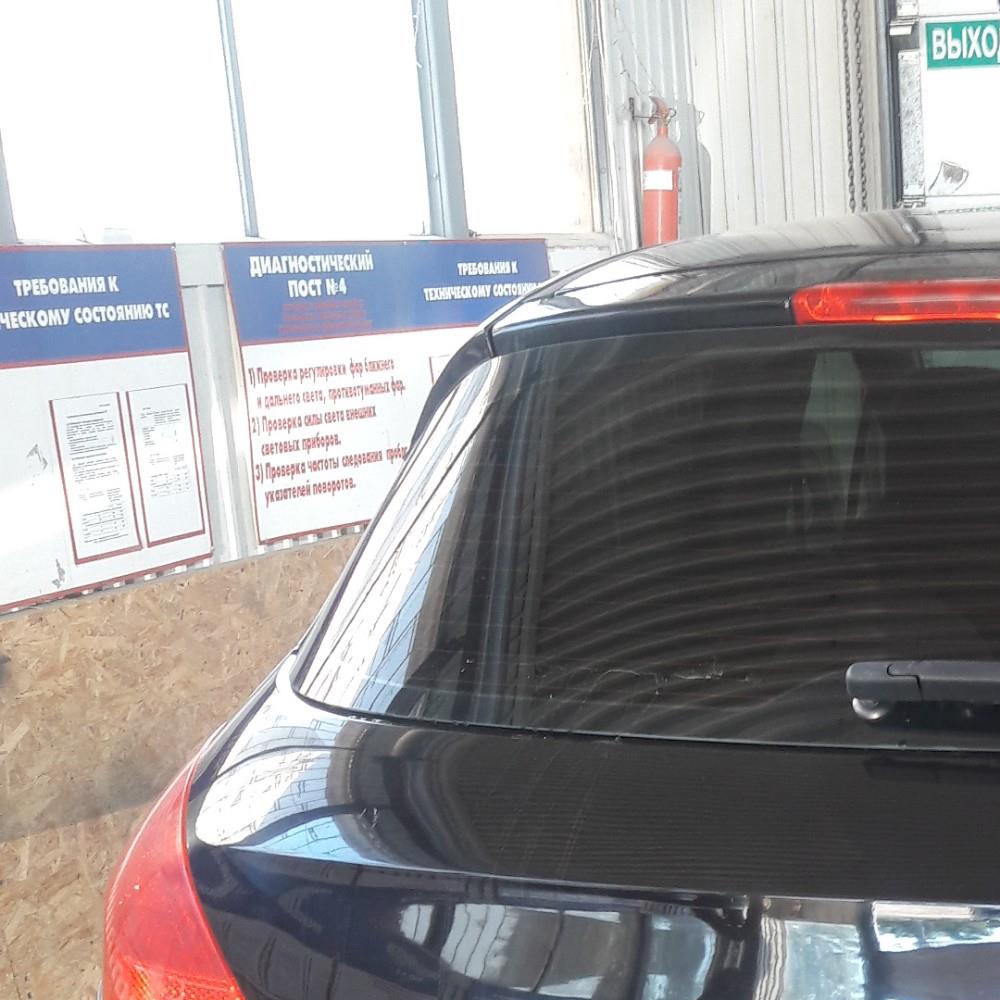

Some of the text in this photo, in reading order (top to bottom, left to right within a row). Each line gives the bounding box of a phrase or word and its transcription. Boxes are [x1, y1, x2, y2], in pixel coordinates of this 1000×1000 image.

[249, 249, 374, 277] ДИАГНОСТИЧЕСКИЙ
[457, 261, 518, 276] ТРЕБОВАНИЯ К
[13, 276, 119, 297] ТРЕБОВАНИЯ К
[288, 279, 322, 297] ПОСТ
[424, 284, 491, 301] ТЕХНИЧЕСКОМУ
[0, 303, 170, 330] ЧЕСКОМУ СОСТОЯНИЮ ТС
[257, 366, 298, 388] Проверка
[300, 363, 346, 385] регулировки
[350, 357, 363, 380] фар
[265, 392, 300, 410] дальнего
[262, 415, 302, 436] Проверка
[324, 411, 344, 424] света
[261, 432, 341, 456] световых приборов.
[265, 462, 306, 482] Проверка
[308, 457, 339, 472] частоты
[265, 477, 356, 507] указателей поворотов.
